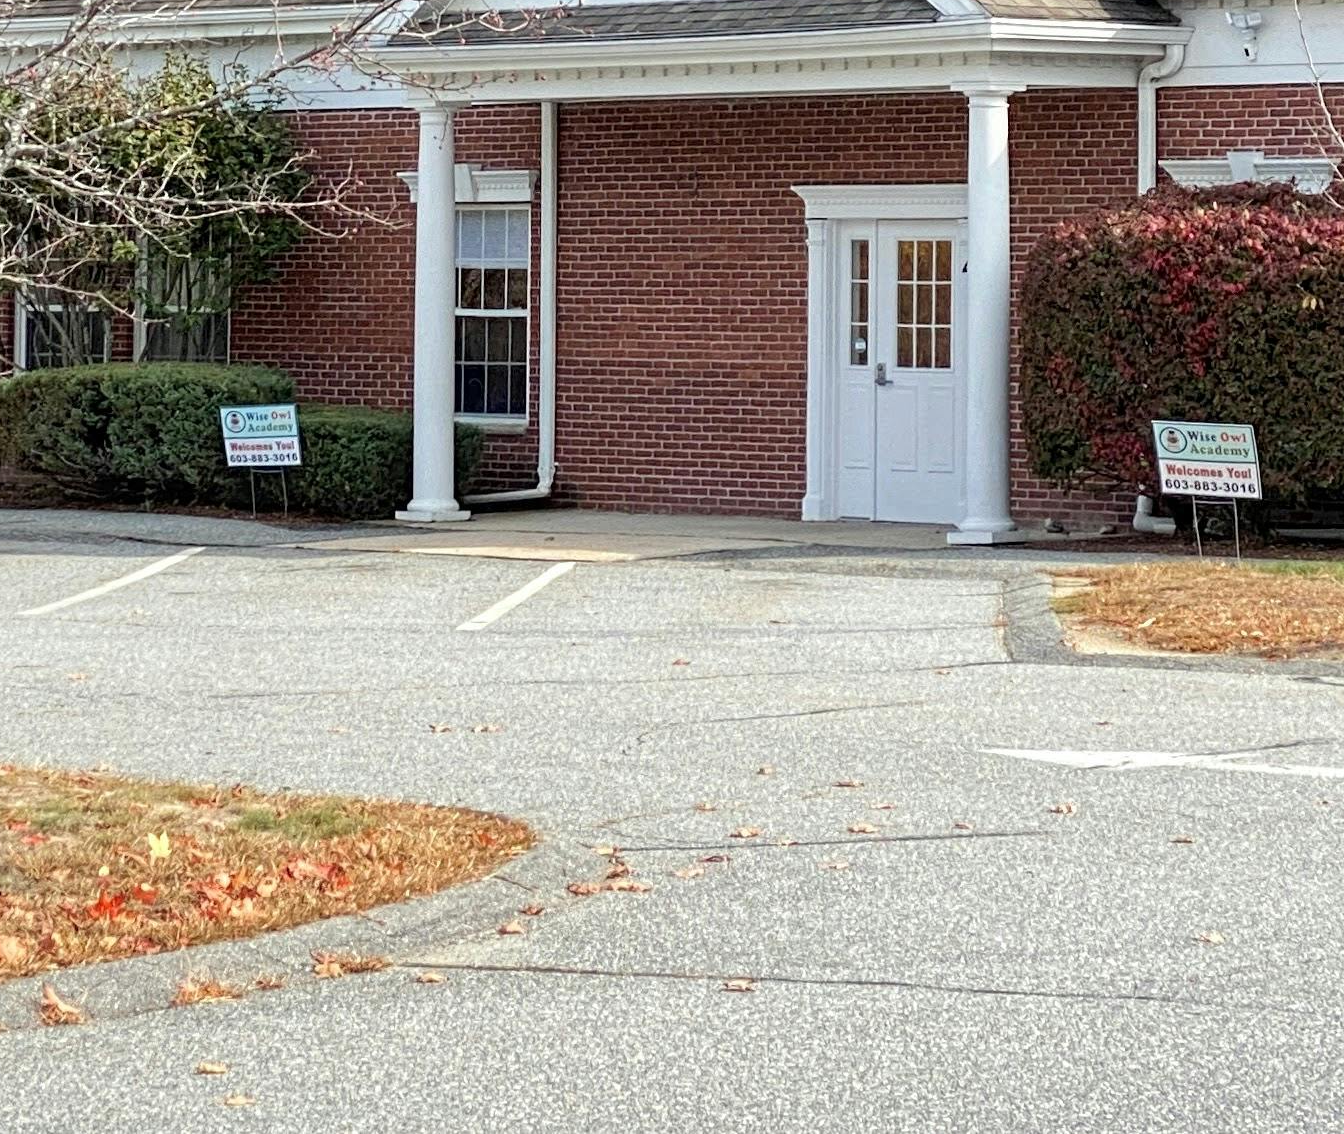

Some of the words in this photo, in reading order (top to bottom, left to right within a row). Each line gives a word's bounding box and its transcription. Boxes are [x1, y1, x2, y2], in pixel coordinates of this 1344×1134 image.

[246, 412, 269, 421] Wise
[271, 411, 292, 420] Owl
[248, 423, 293, 433] Academy
[1187, 430, 1216, 442] Wise
[1220, 432, 1247, 443] Owl
[229, 442, 273, 451] Welcomes
[275, 441, 295, 450] You!
[1190, 444, 1250, 458] Academy
[230, 453, 298, 463] 603-883-3016
[1166, 464, 1223, 477] Welcomes
[1226, 467, 1252, 479] You!
[1165, 478, 1256, 494] 603-883-3016
